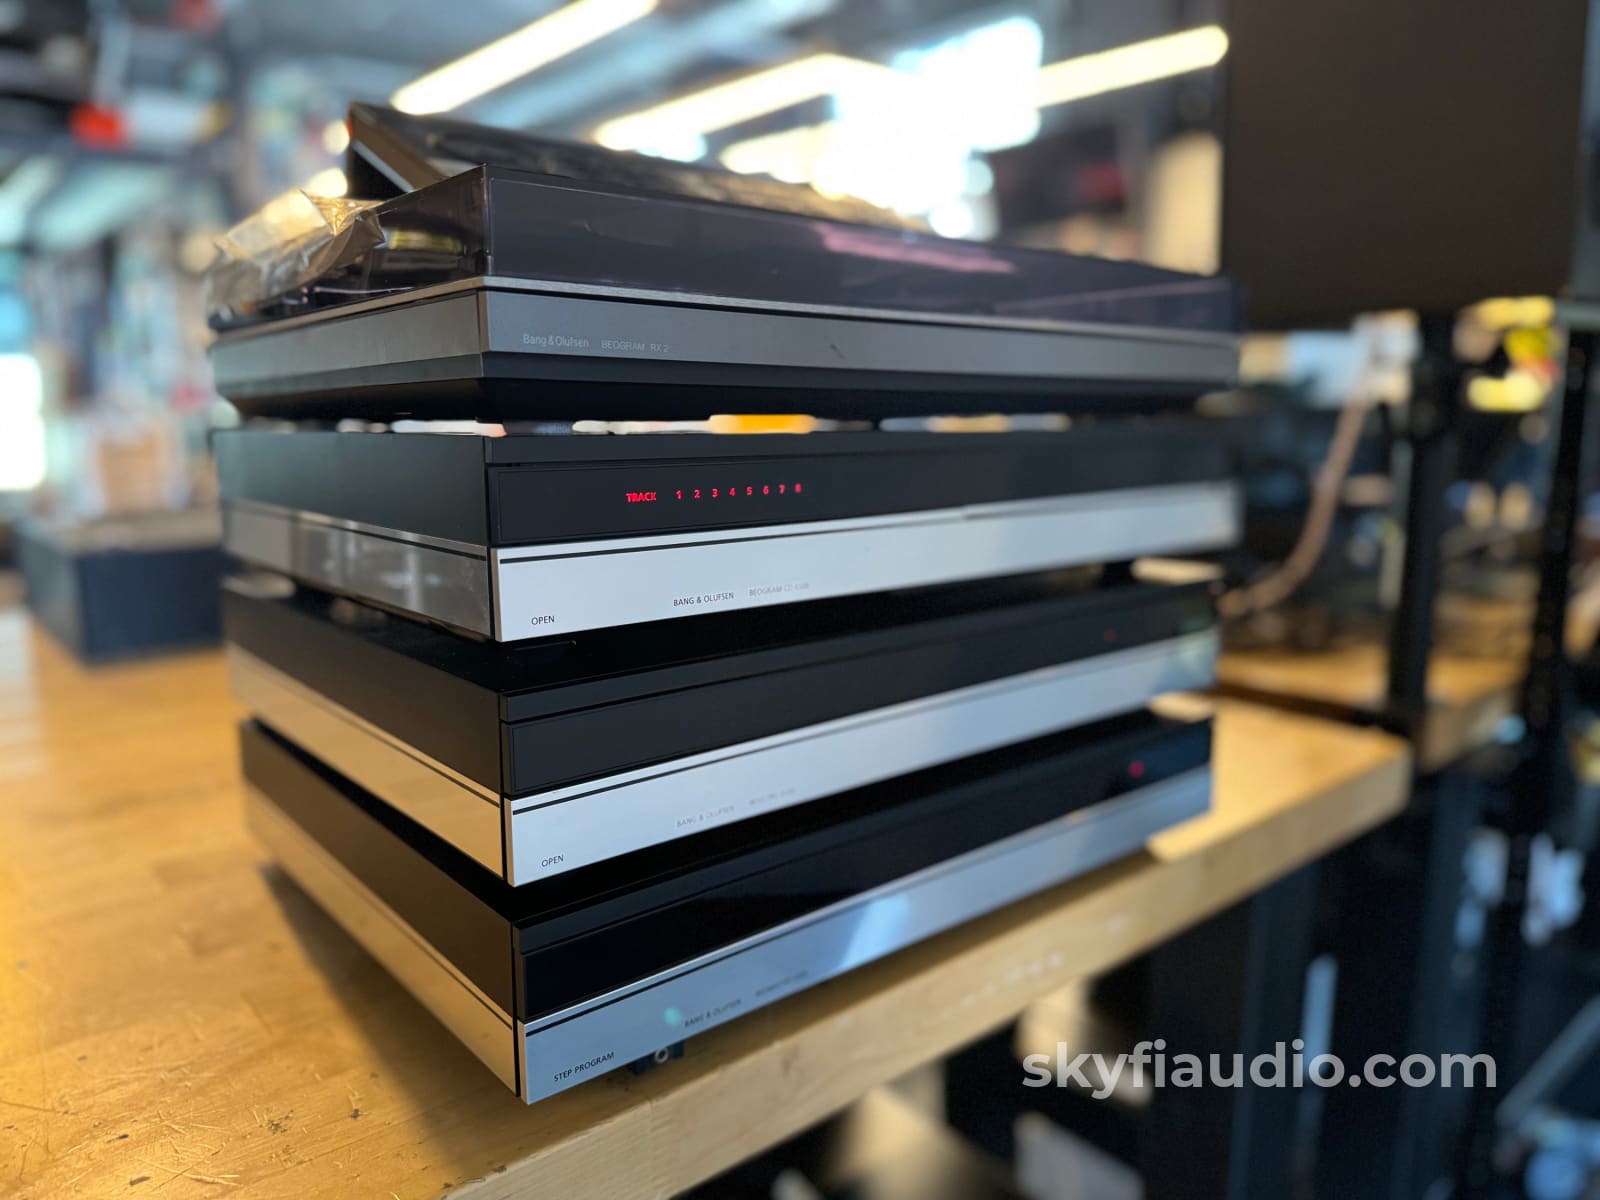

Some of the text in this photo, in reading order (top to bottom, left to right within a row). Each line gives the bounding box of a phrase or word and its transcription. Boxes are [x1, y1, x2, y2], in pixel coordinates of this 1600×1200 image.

[523, 333, 546, 347] Bang
[555, 335, 589, 348] Olufsen
[601, 339, 645, 351] BEOGRAM
[650, 343, 662, 352] RX
[626, 492, 657, 503] TRACK
[676, 490, 682, 499] 1
[694, 489, 701, 499] 2
[712, 488, 719, 498] 3
[729, 487, 736, 497] 4
[746, 486, 753, 496] 5
[763, 485, 769, 495] 6
[779, 484, 785, 494] 7
[673, 596, 695, 607] BANG
[704, 592, 734, 603] OLUFSEN
[531, 615, 555, 626] OPEN
[541, 854, 564, 868] OPEN
[553, 1051, 615, 1083] STEP PROGRAM
